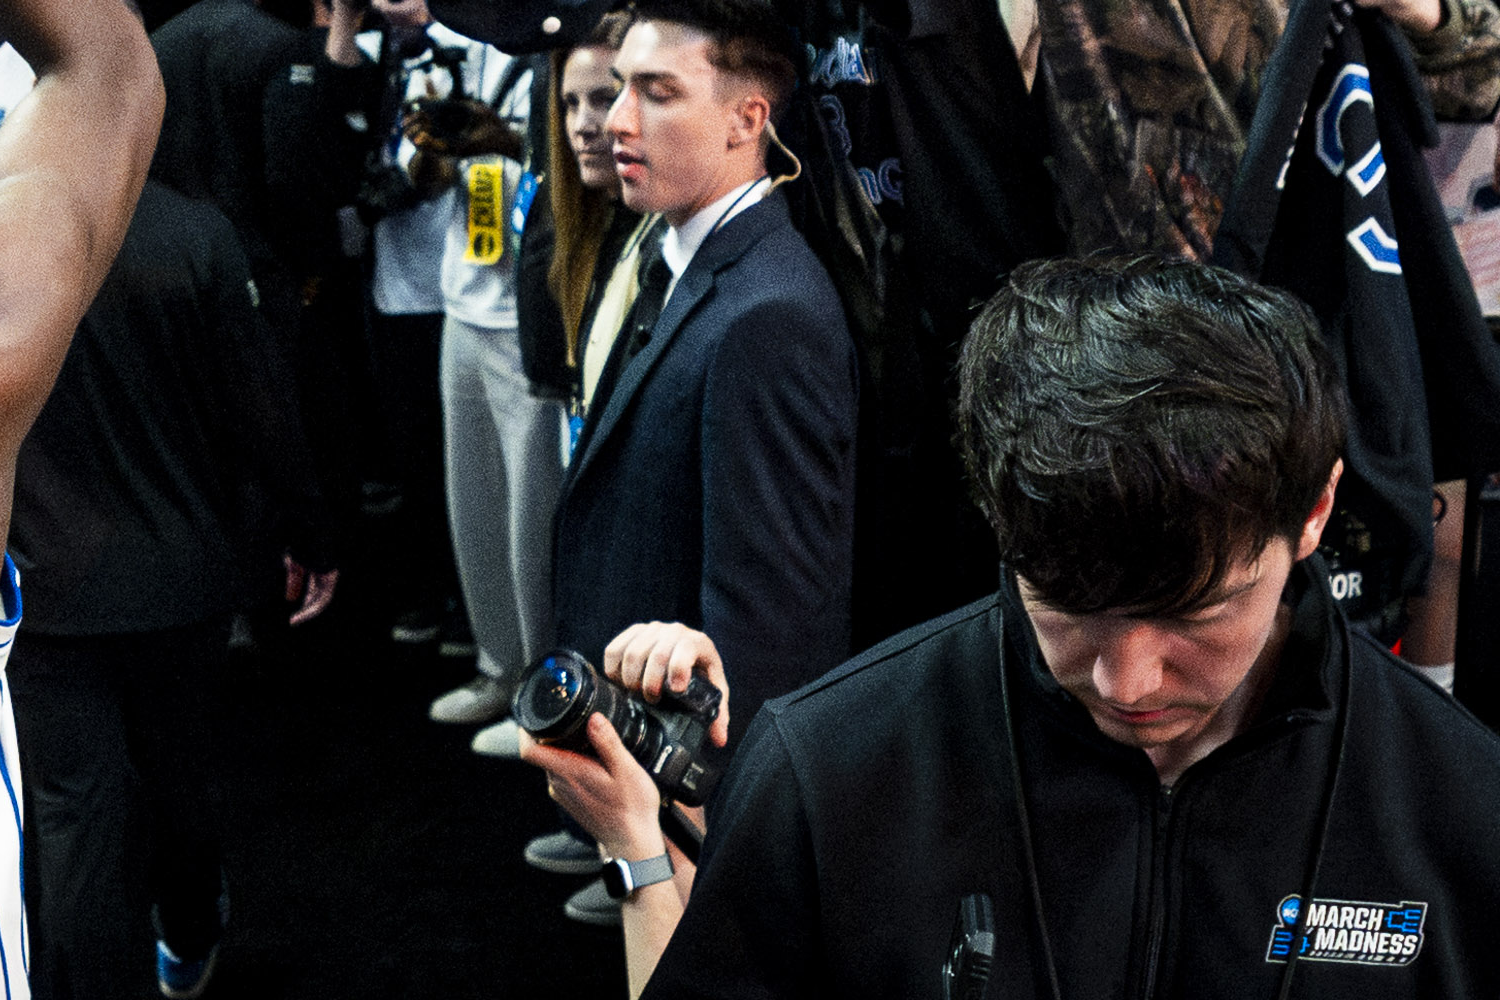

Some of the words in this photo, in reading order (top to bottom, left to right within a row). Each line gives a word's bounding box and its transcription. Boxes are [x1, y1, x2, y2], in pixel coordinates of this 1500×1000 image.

[1328, 571, 1363, 601] OR
[1305, 903, 1384, 931] MARCH
[1314, 927, 1419, 956] MADNESS
